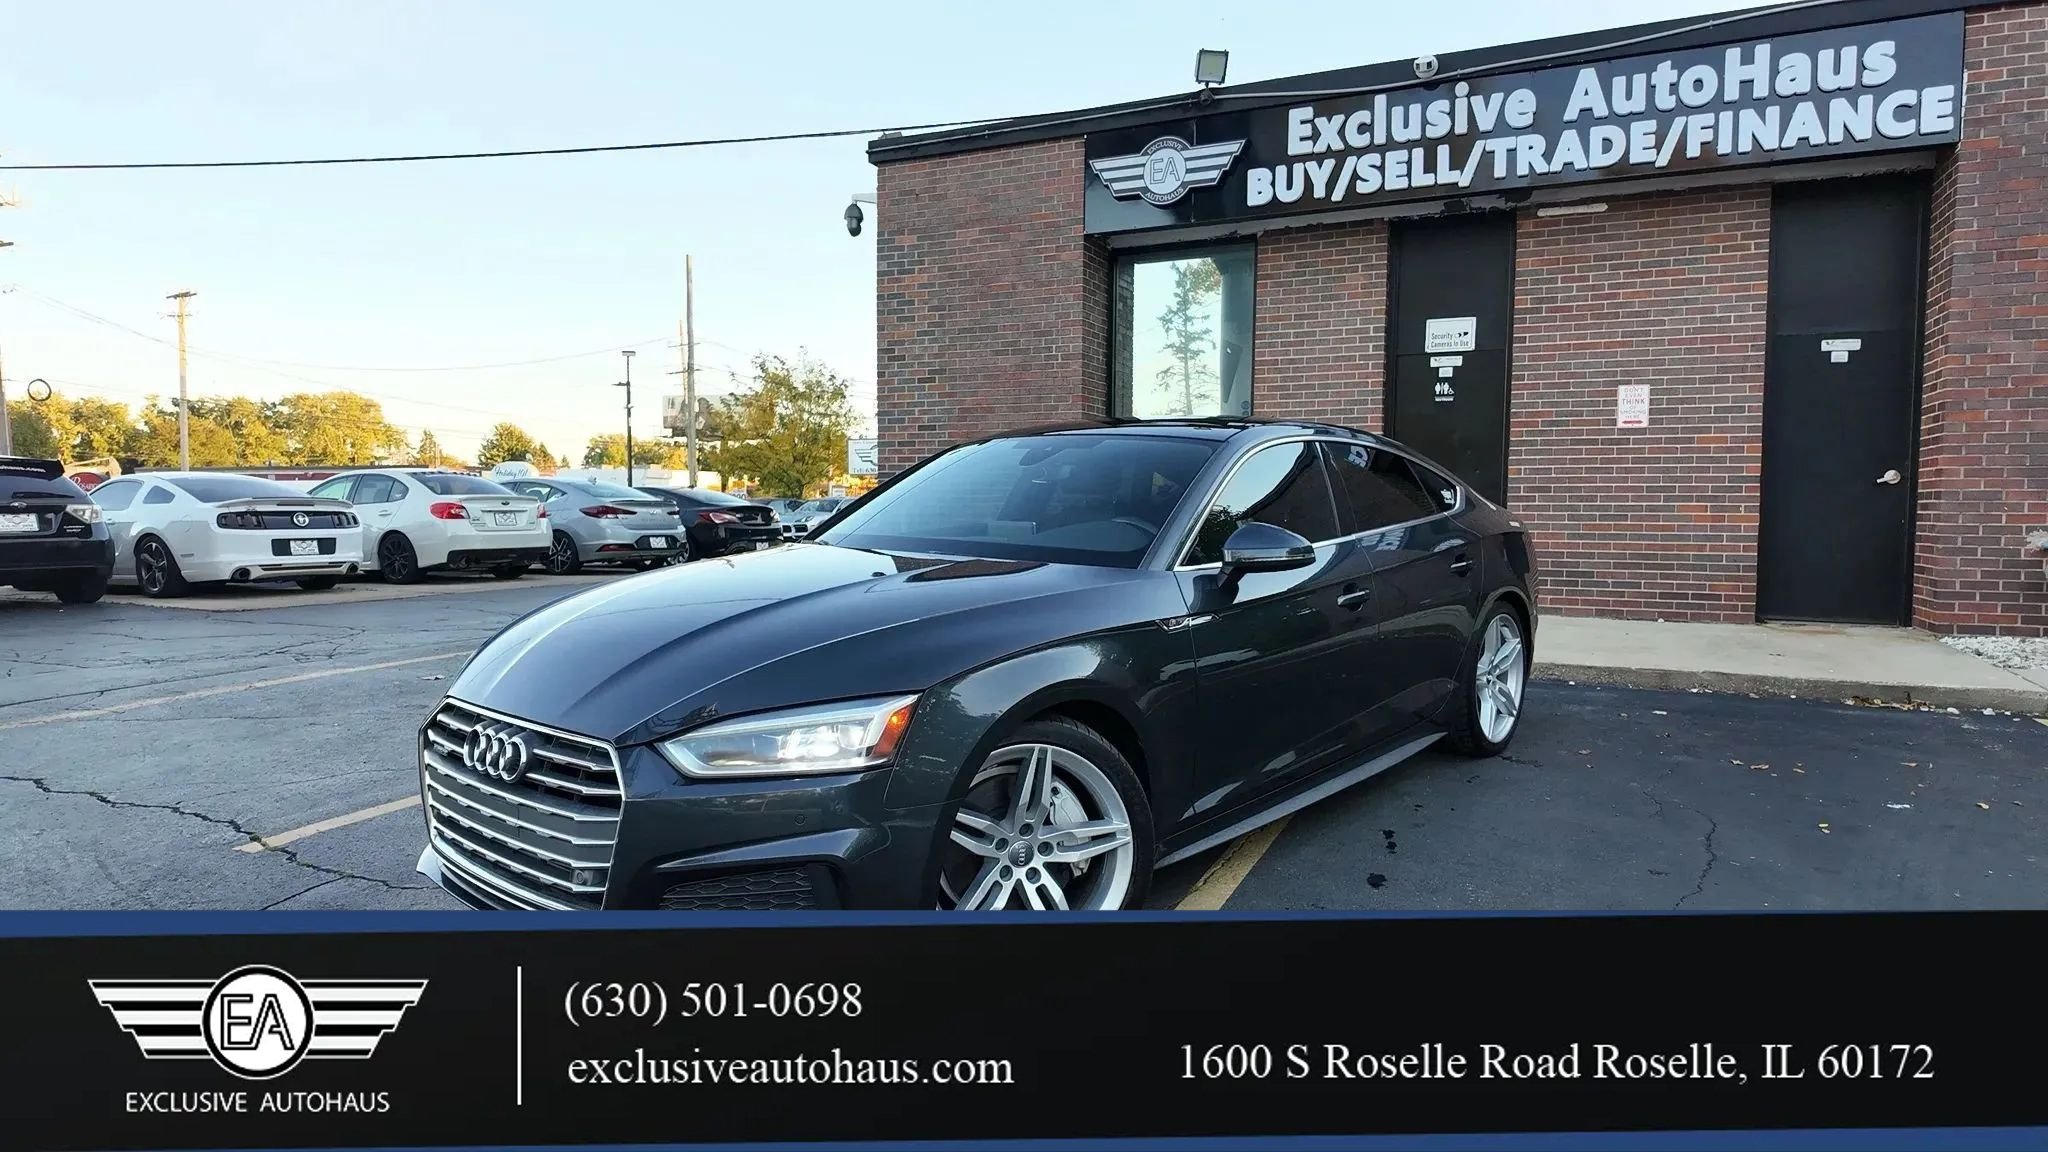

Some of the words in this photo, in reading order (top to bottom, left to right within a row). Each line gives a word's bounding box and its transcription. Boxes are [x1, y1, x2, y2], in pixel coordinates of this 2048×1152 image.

[1287, 81, 1537, 157] Exclusive
[1563, 39, 1897, 123] AutoHaus
[1147, 140, 1183, 155] EXCLUSIVE
[1246, 84, 1955, 207] BUY/SELL/TRADE/FINANCE
[1150, 156, 1181, 184] EA
[1145, 187, 1184, 202] AUTOHAUS
[1431, 332, 1453, 340] Security
[1430, 340, 1453, 348] Cameras
